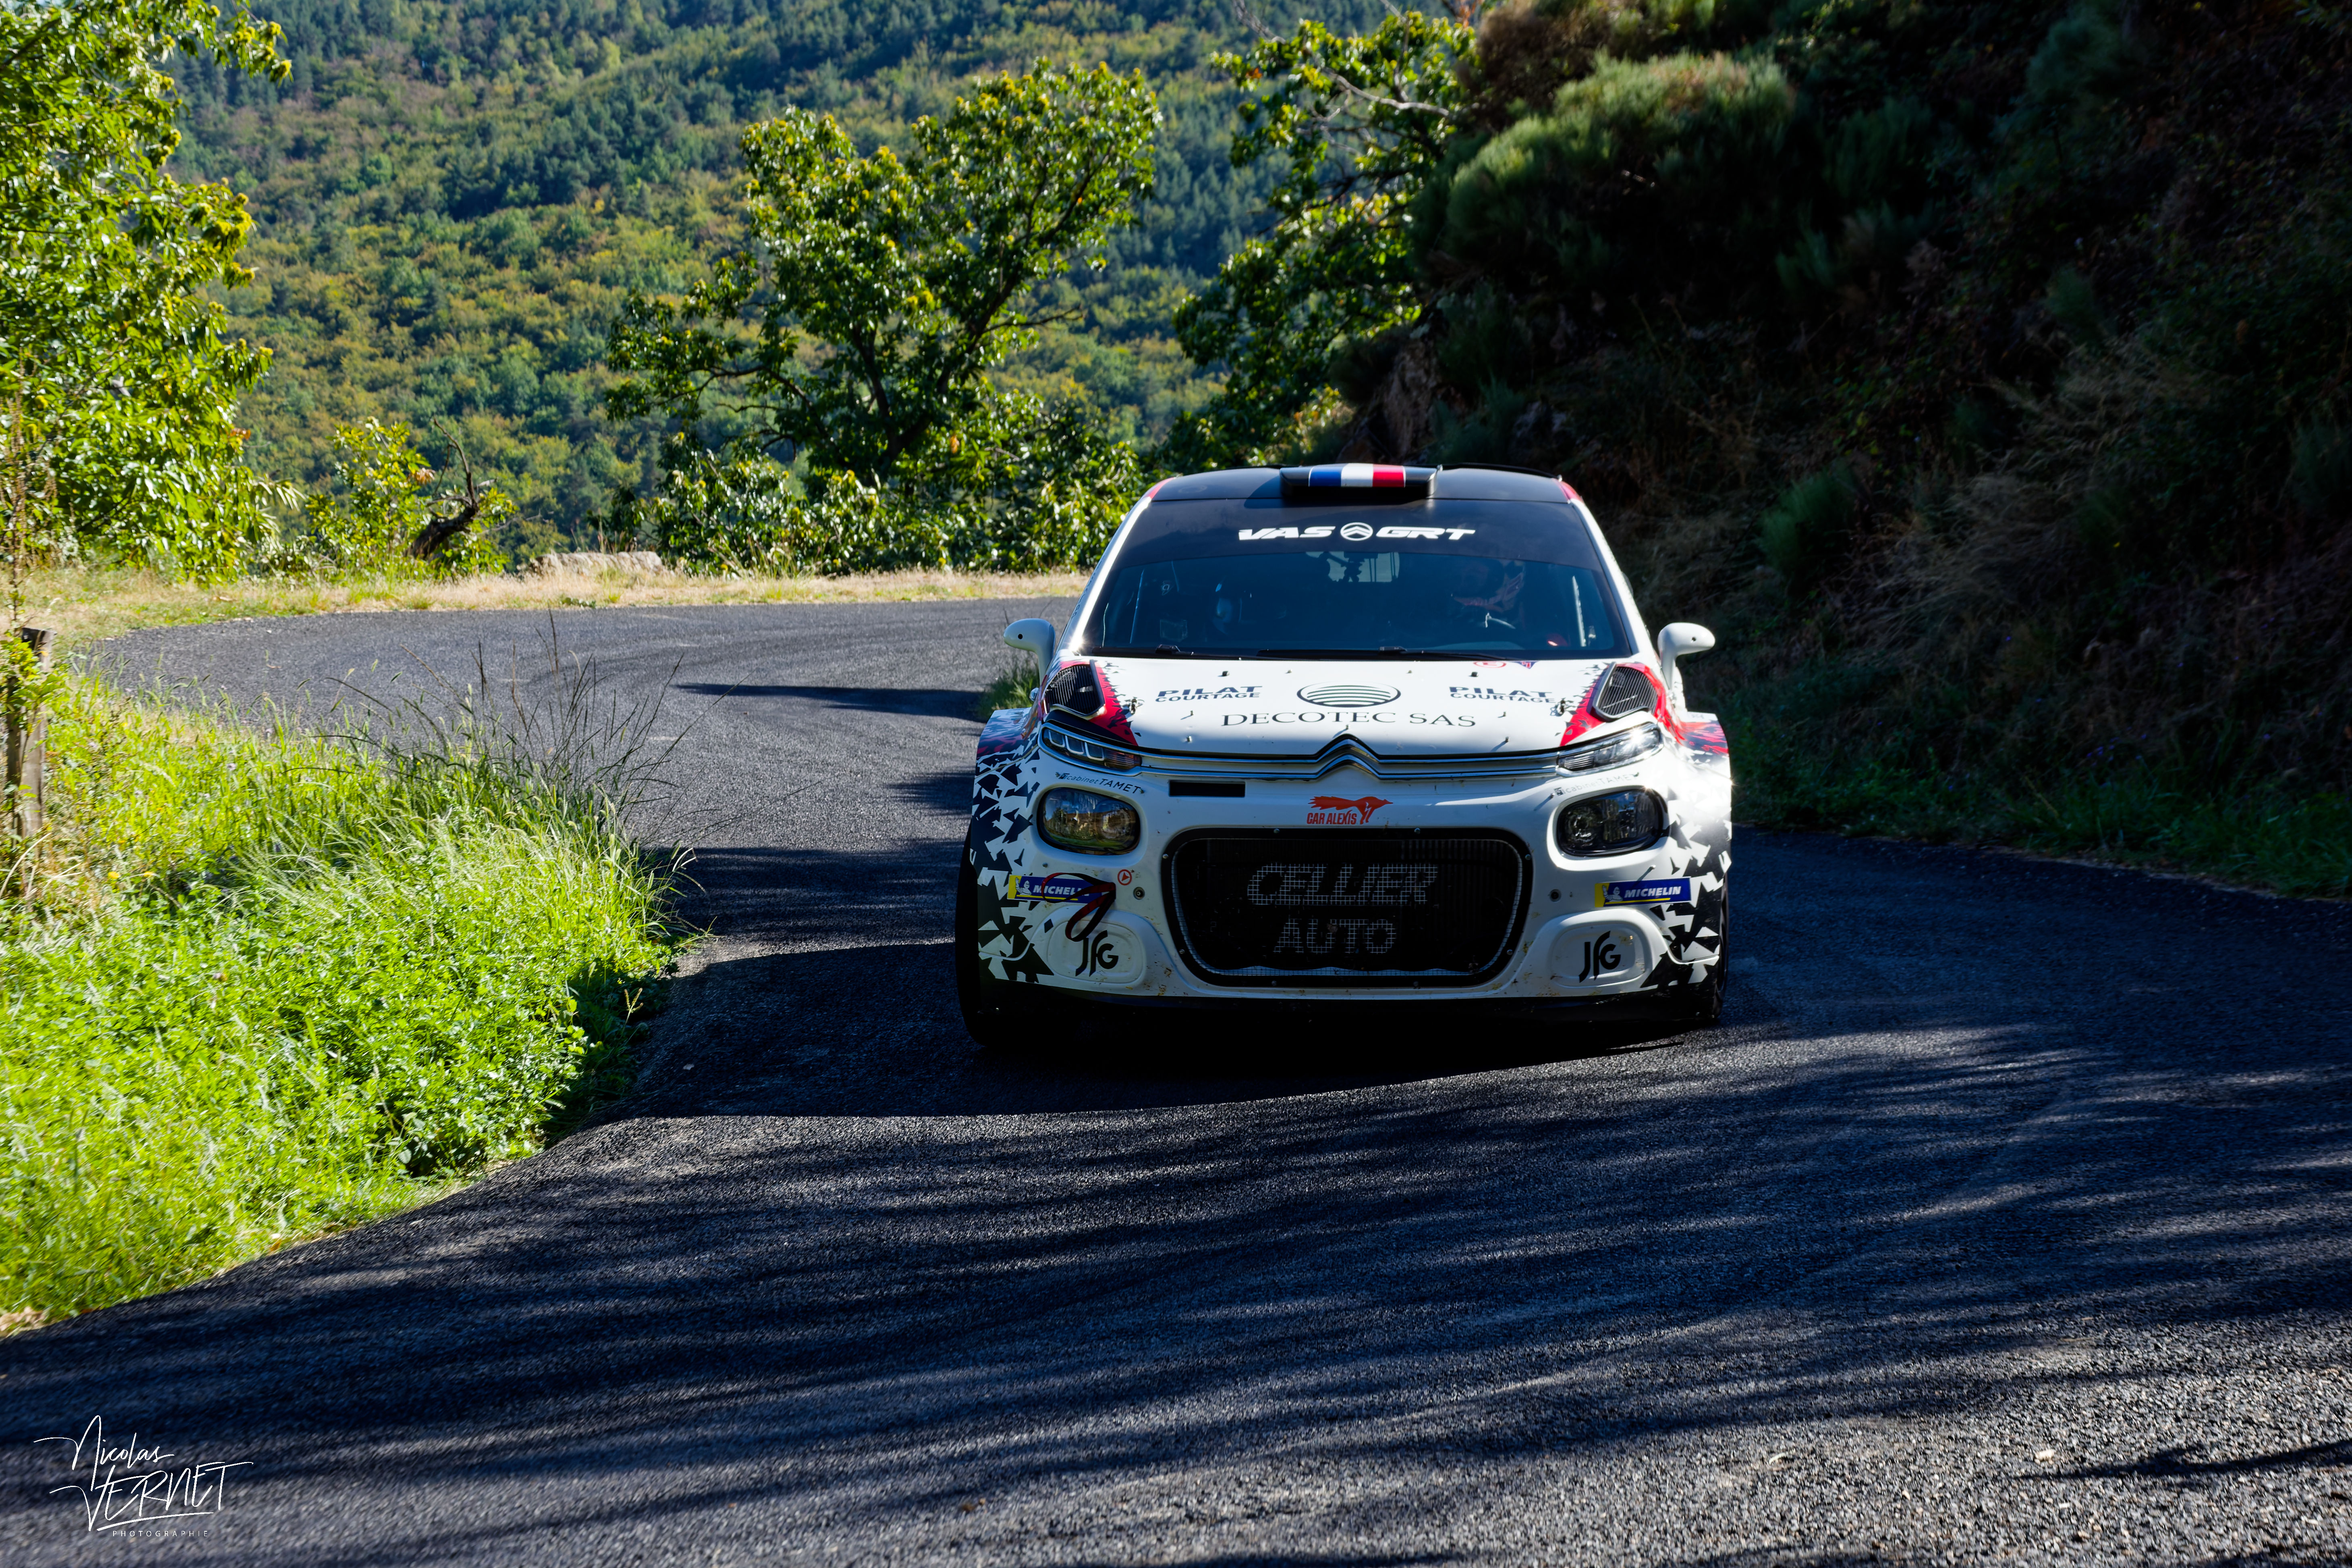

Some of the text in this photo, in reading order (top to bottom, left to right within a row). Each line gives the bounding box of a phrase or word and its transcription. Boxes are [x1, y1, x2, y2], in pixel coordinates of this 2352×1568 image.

[1238, 525, 1476, 541] VAS GRT
[1155, 692, 1261, 702] COURTAGE
[1157, 686, 1263, 697] PILAT
[1449, 686, 1553, 698] PILAT
[1450, 693, 1556, 703] COURTAGE
[1221, 711, 1476, 727] DECOTEC SAS
[1099, 778, 1141, 794] TAMET
[1306, 809, 1357, 825] CAR ALEXIS
[1247, 861, 1439, 906] CELLIER
[1033, 885, 1090, 897] MICHEL
[1624, 886, 1682, 898] MICHELIN
[1272, 918, 1397, 954] AUTO
